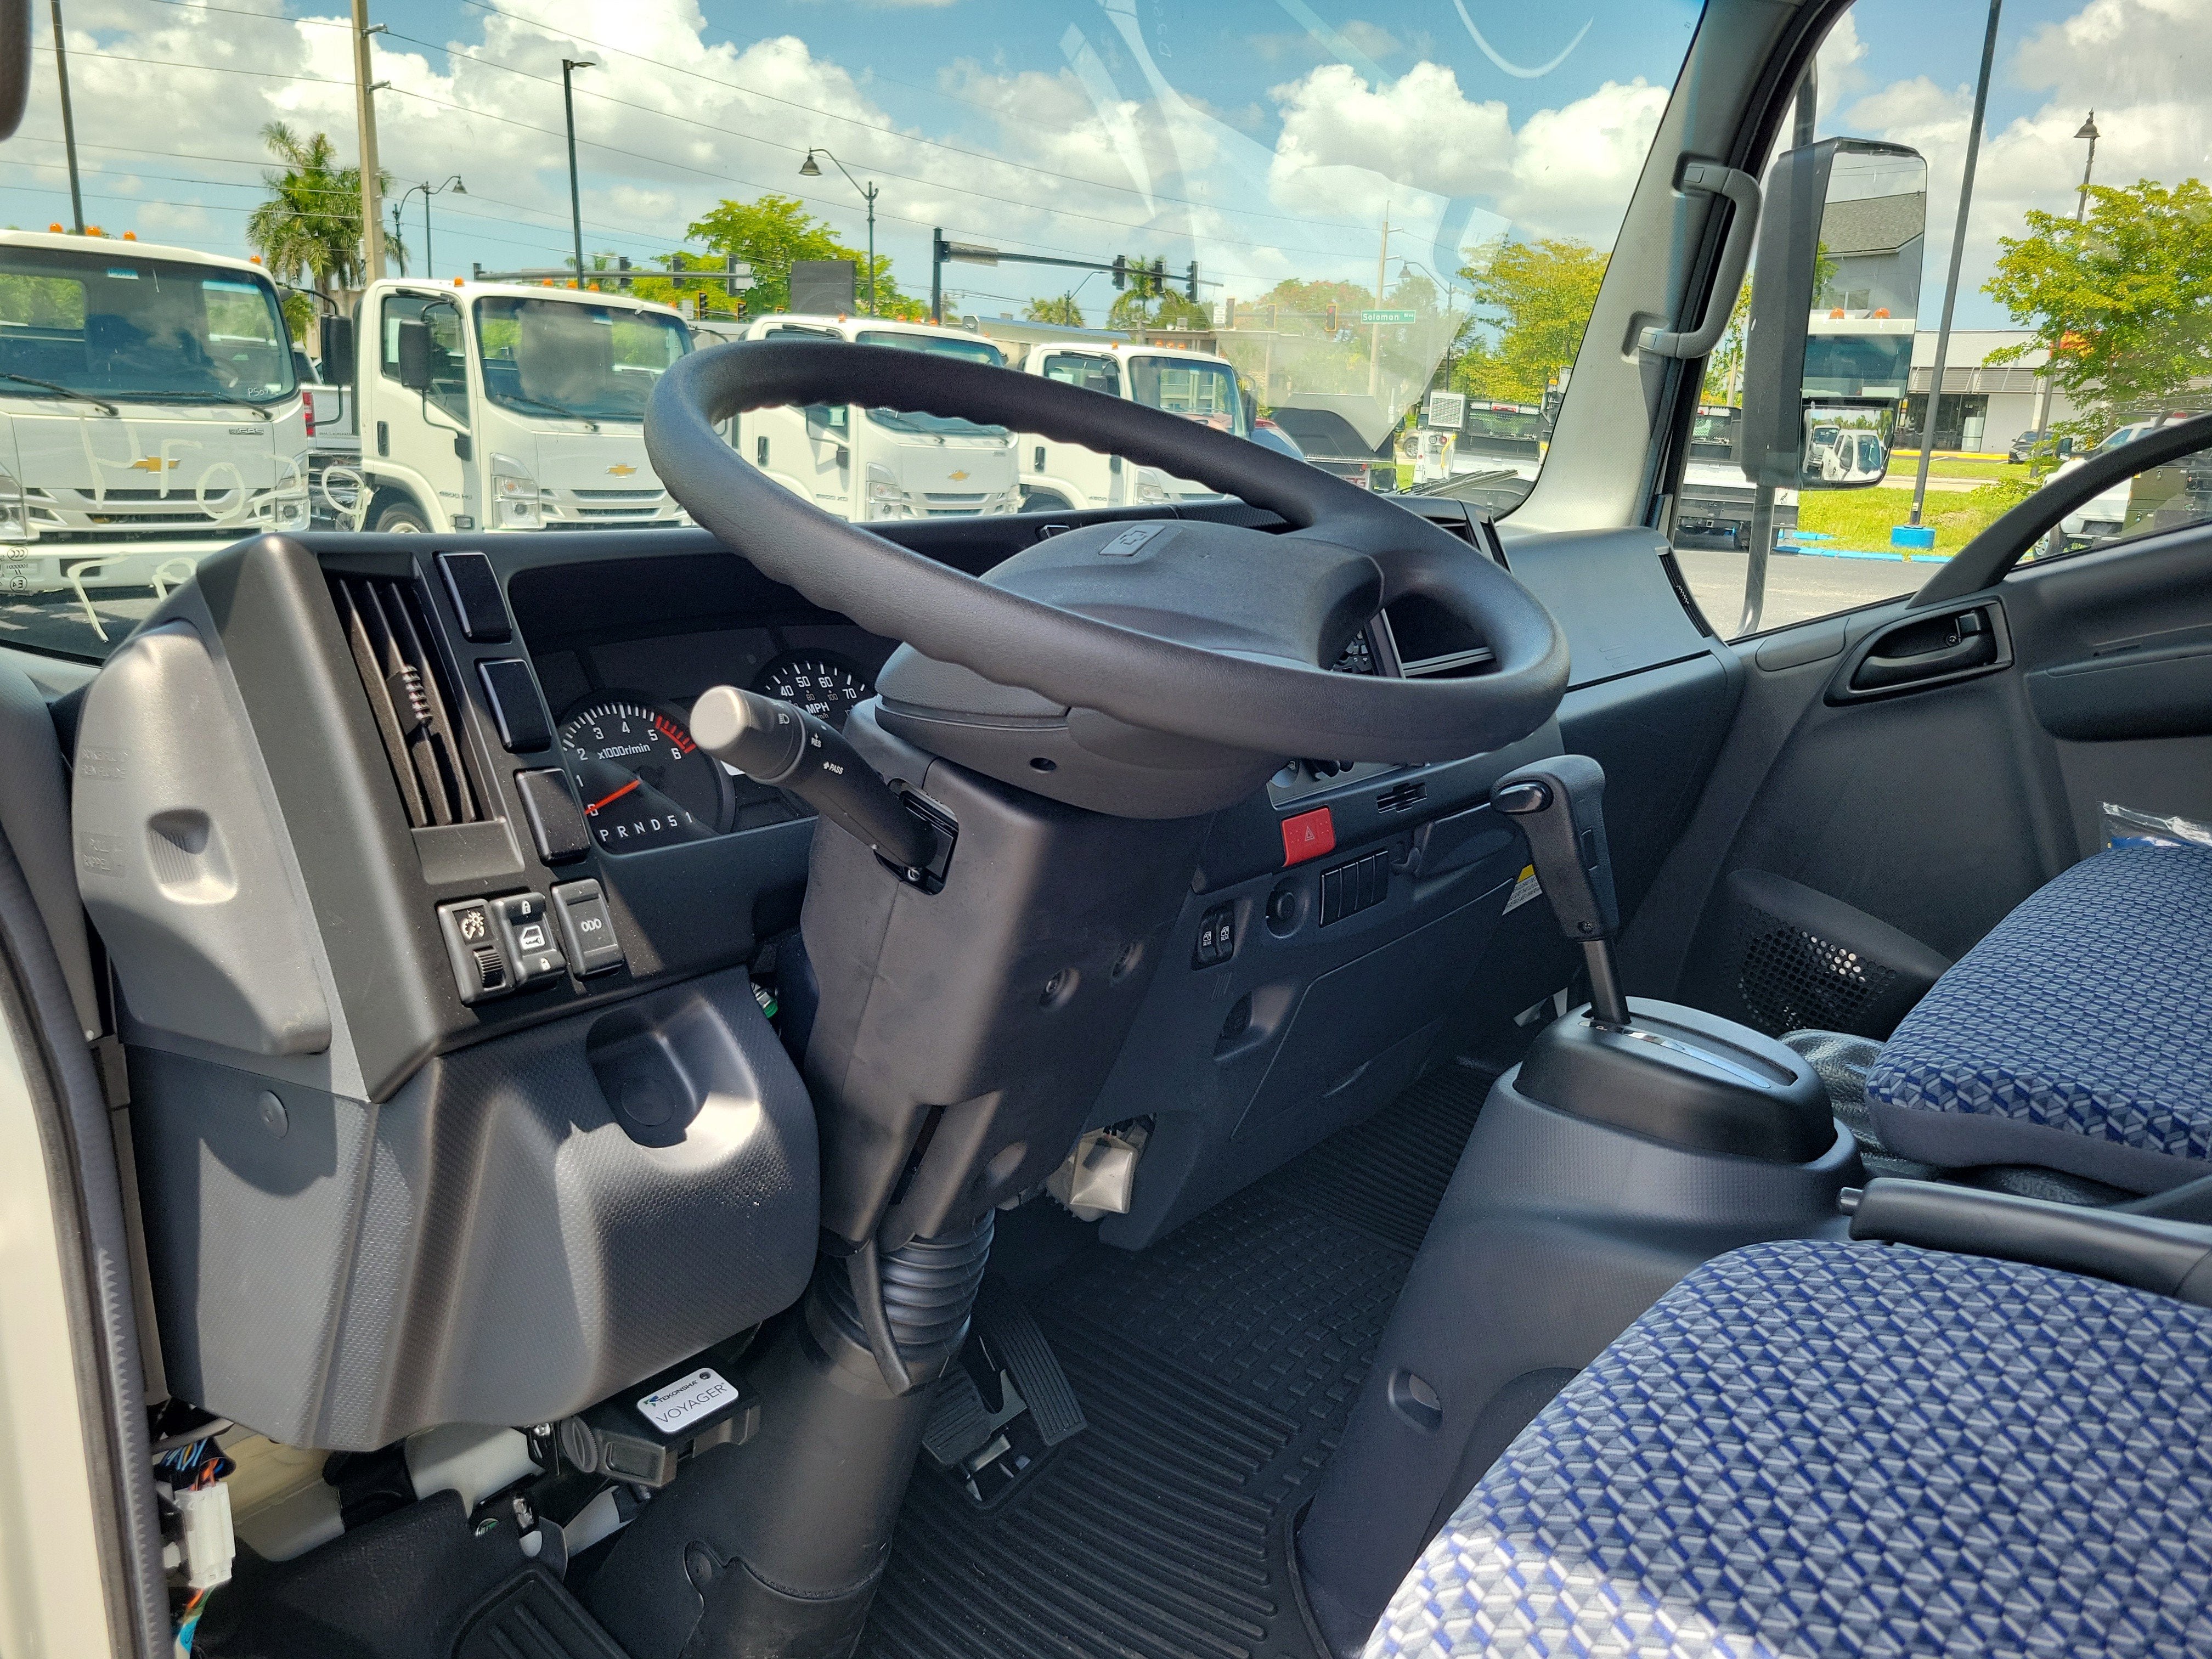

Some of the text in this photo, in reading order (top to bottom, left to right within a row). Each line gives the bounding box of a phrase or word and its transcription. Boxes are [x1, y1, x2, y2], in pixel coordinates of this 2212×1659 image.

[795, 676, 811, 687] 50
[819, 676, 833, 688] 60
[781, 685, 794, 697] 40
[842, 688, 857, 699] 70
[805, 702, 830, 714] MPH
[622, 721, 630, 733] 4
[593, 727, 604, 740] 3
[647, 729, 658, 741] 5
[811, 738, 821, 748] RES
[577, 748, 588, 760] 2
[597, 743, 651, 759] x1000r/min
[671, 747, 682, 759] 6
[829, 763, 844, 775] PASS
[576, 775, 584, 787] 1
[588, 803, 599, 816] 0
[600, 811, 693, 842] P R N D 5 1
[582, 918, 602, 932] ODO
[658, 1380, 698, 1403] TEKONSHA
